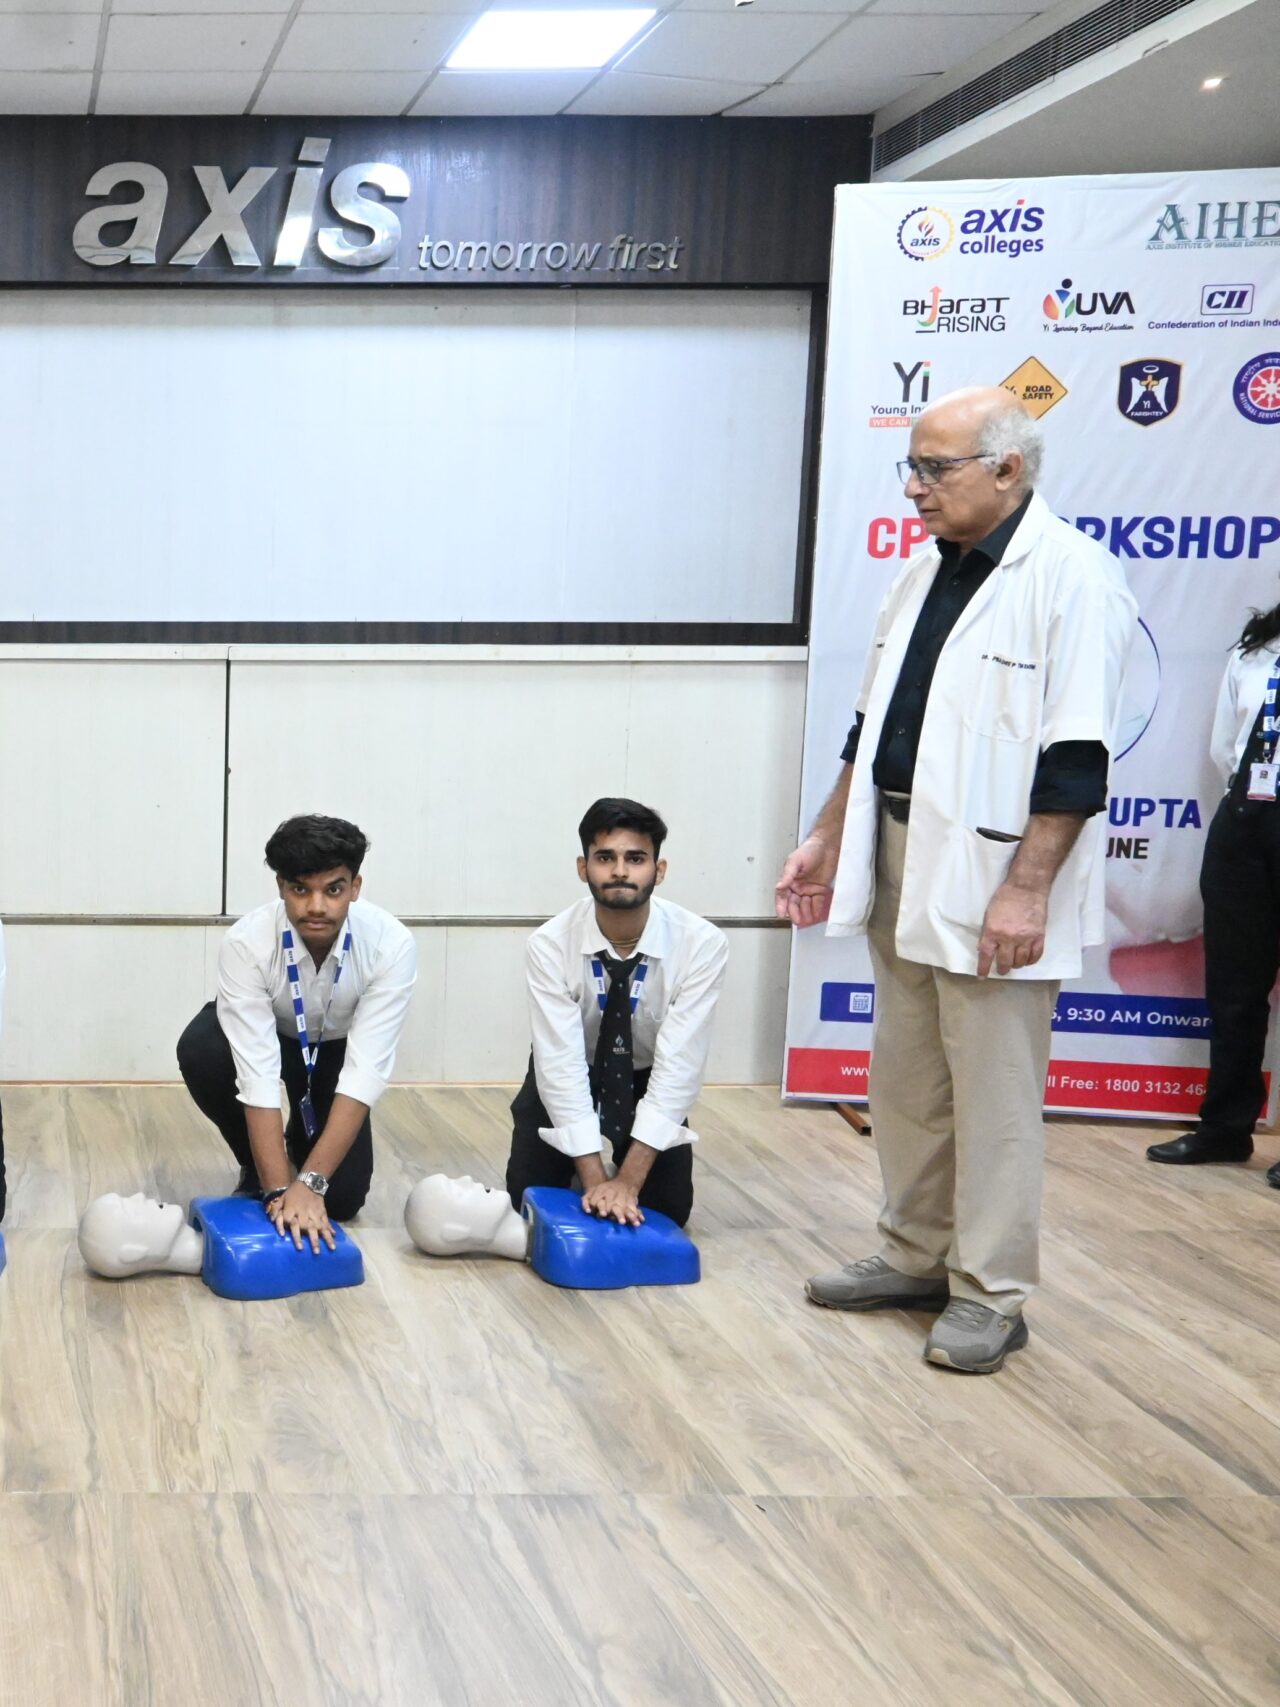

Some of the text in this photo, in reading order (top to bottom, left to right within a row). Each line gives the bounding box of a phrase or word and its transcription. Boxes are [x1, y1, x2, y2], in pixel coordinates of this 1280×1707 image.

[72, 137, 411, 267] axis
[960, 199, 1045, 234] axis
[910, 236, 941, 247] axis
[959, 234, 1045, 258] colleges
[418, 234, 684, 271] tomorrow first
[1206, 290, 1249, 309] CII
[936, 315, 1007, 333] RISING
[1147, 320, 1216, 330] Confederation
[1218, 320, 1228, 328] of
[1230, 319, 1260, 328] Indian
[892, 361, 931, 403] Yi
[1025, 385, 1052, 393] ROAD
[1022, 392, 1055, 401] SAFETY
[871, 405, 908, 416] Young
[872, 418, 909, 427] WE CAN
[867, 515, 1280, 560] CP RKSHOP
[1108, 796, 1202, 829] UPTA
[1067, 1007, 1106, 1022] 9:30
[1110, 1010, 1141, 1024] AM
[1147, 1011, 1212, 1028] Onwar
[1047, 1075, 1207, 1096] ll Free: 1800 3132 46
